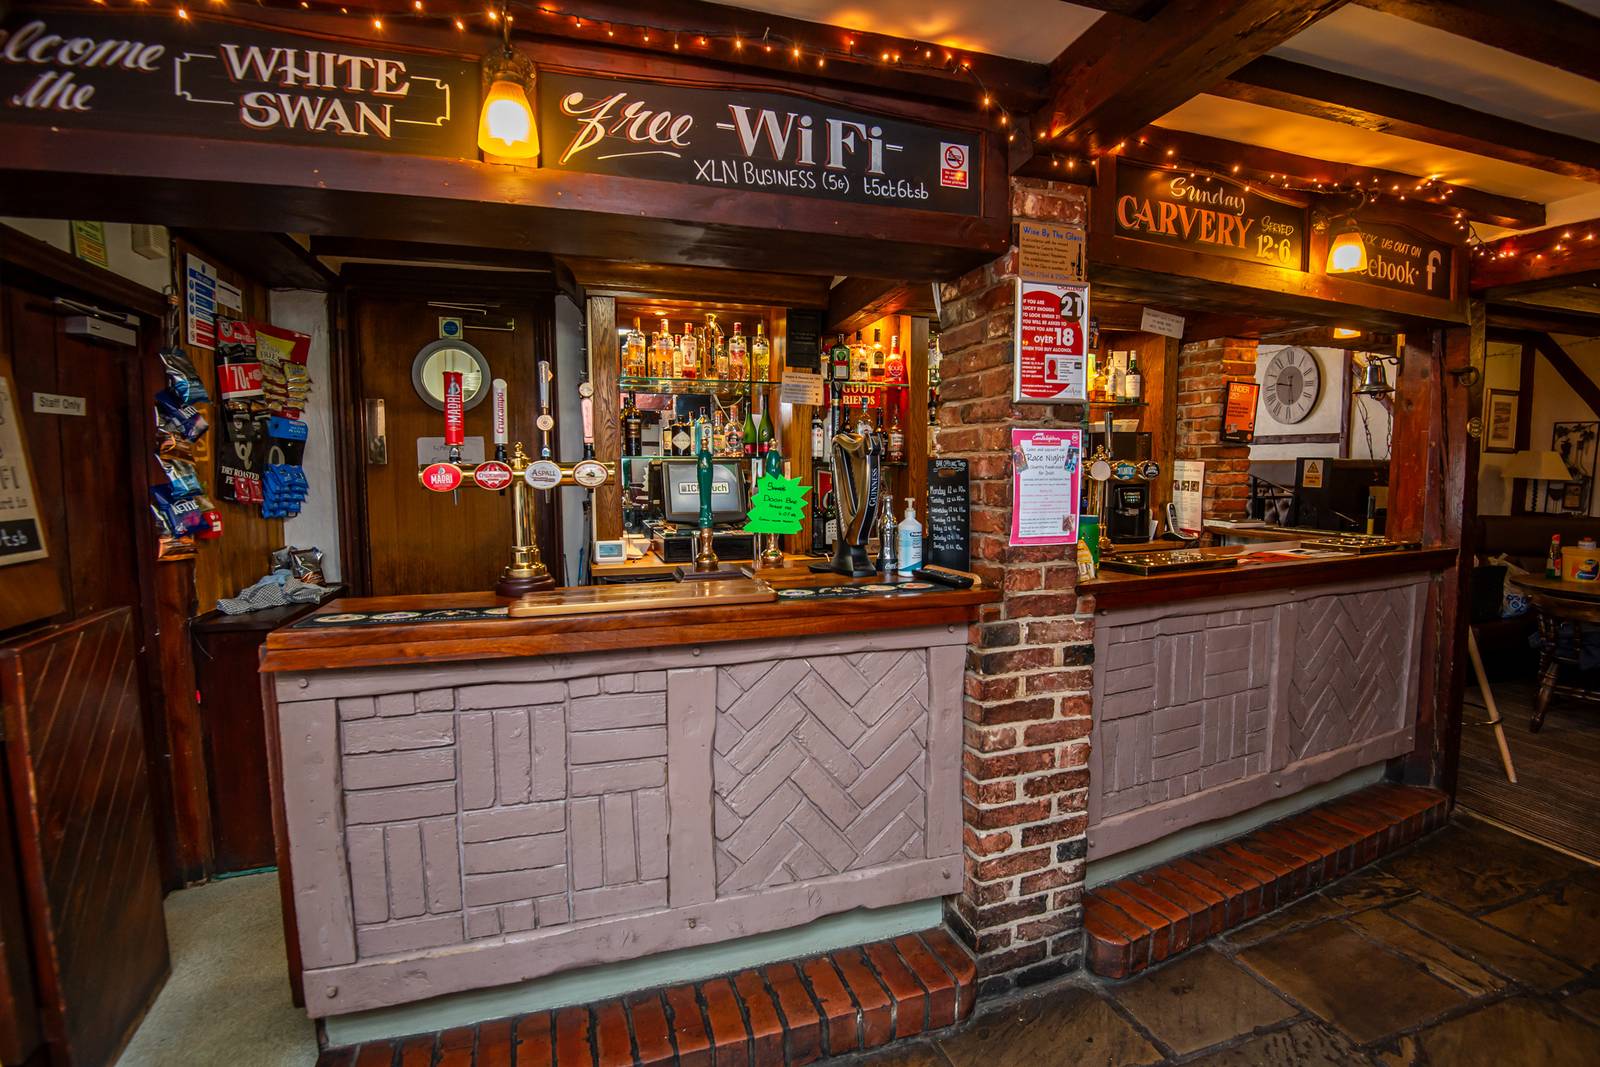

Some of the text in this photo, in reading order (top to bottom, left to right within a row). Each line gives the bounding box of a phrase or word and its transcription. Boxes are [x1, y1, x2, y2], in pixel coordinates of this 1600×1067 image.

[0, 20, 166, 72] lcome
[219, 42, 411, 98] WHITE
[11, 70, 96, 111] the
[239, 91, 394, 139] SWAN
[559, 91, 694, 164] Free
[693, 158, 738, 186] XLN
[1170, 177, 1247, 215] Sunday
[1117, 194, 1255, 250] CARVERY
[1381, 238, 1393, 249] US
[1393, 242, 1410, 254] OUT
[1411, 245, 1422, 258] ON
[1060, 295, 1083, 318] 21
[1033, 327, 1075, 347] OVER 18
[842, 383, 876, 394] GOOD
[39, 396, 82, 412] Staff Only
[495, 392, 505, 435] Cruzcampo
[531, 468, 557, 477] ASPALL
[1026, 452, 1065, 465] Race Night
[220, 465, 234, 476] DRY
[233, 468, 260, 482] ROASTED
[869, 467, 879, 508] GUINNESS
[686, 483, 728, 493] ICuch
